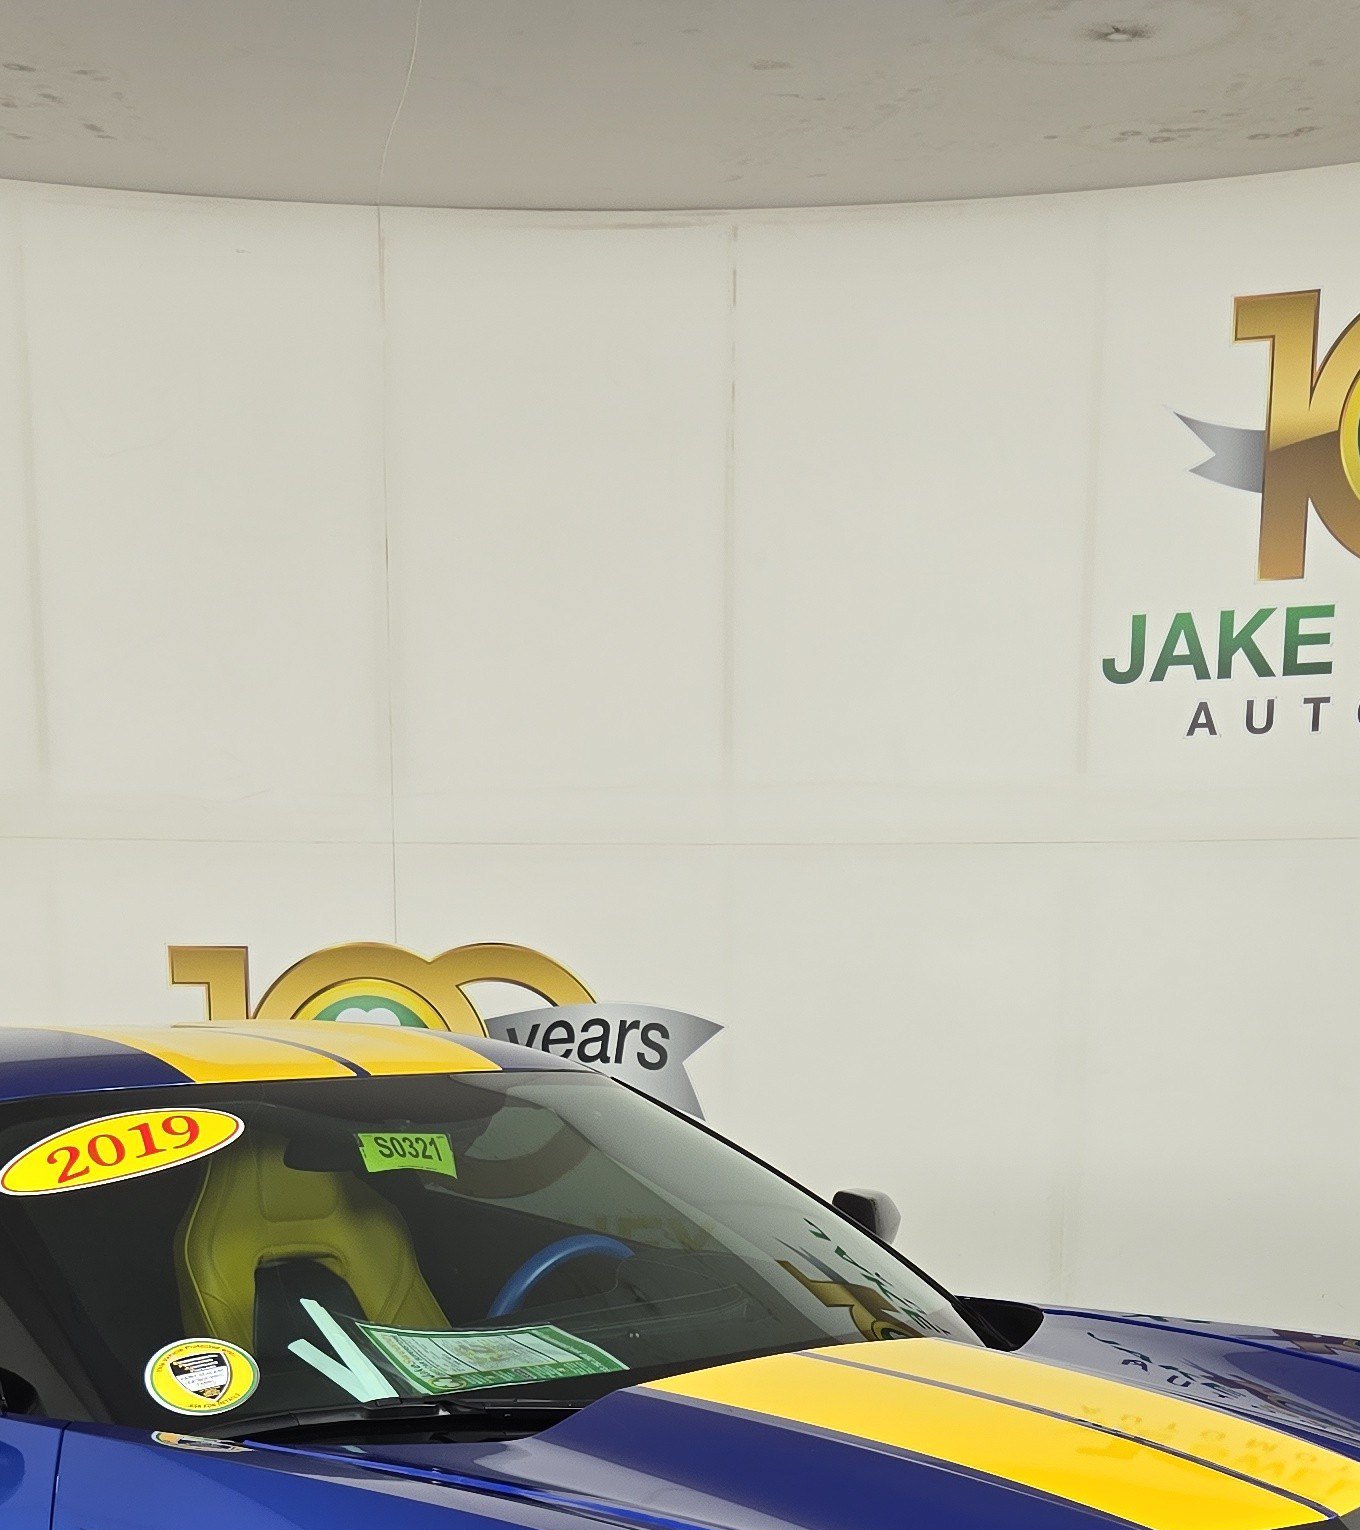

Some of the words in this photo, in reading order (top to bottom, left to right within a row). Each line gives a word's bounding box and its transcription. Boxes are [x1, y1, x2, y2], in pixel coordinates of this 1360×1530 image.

[1102, 603, 1335, 684] JAKE
[47, 1115, 200, 1184] 2019
[374, 1136, 442, 1161] S0321
